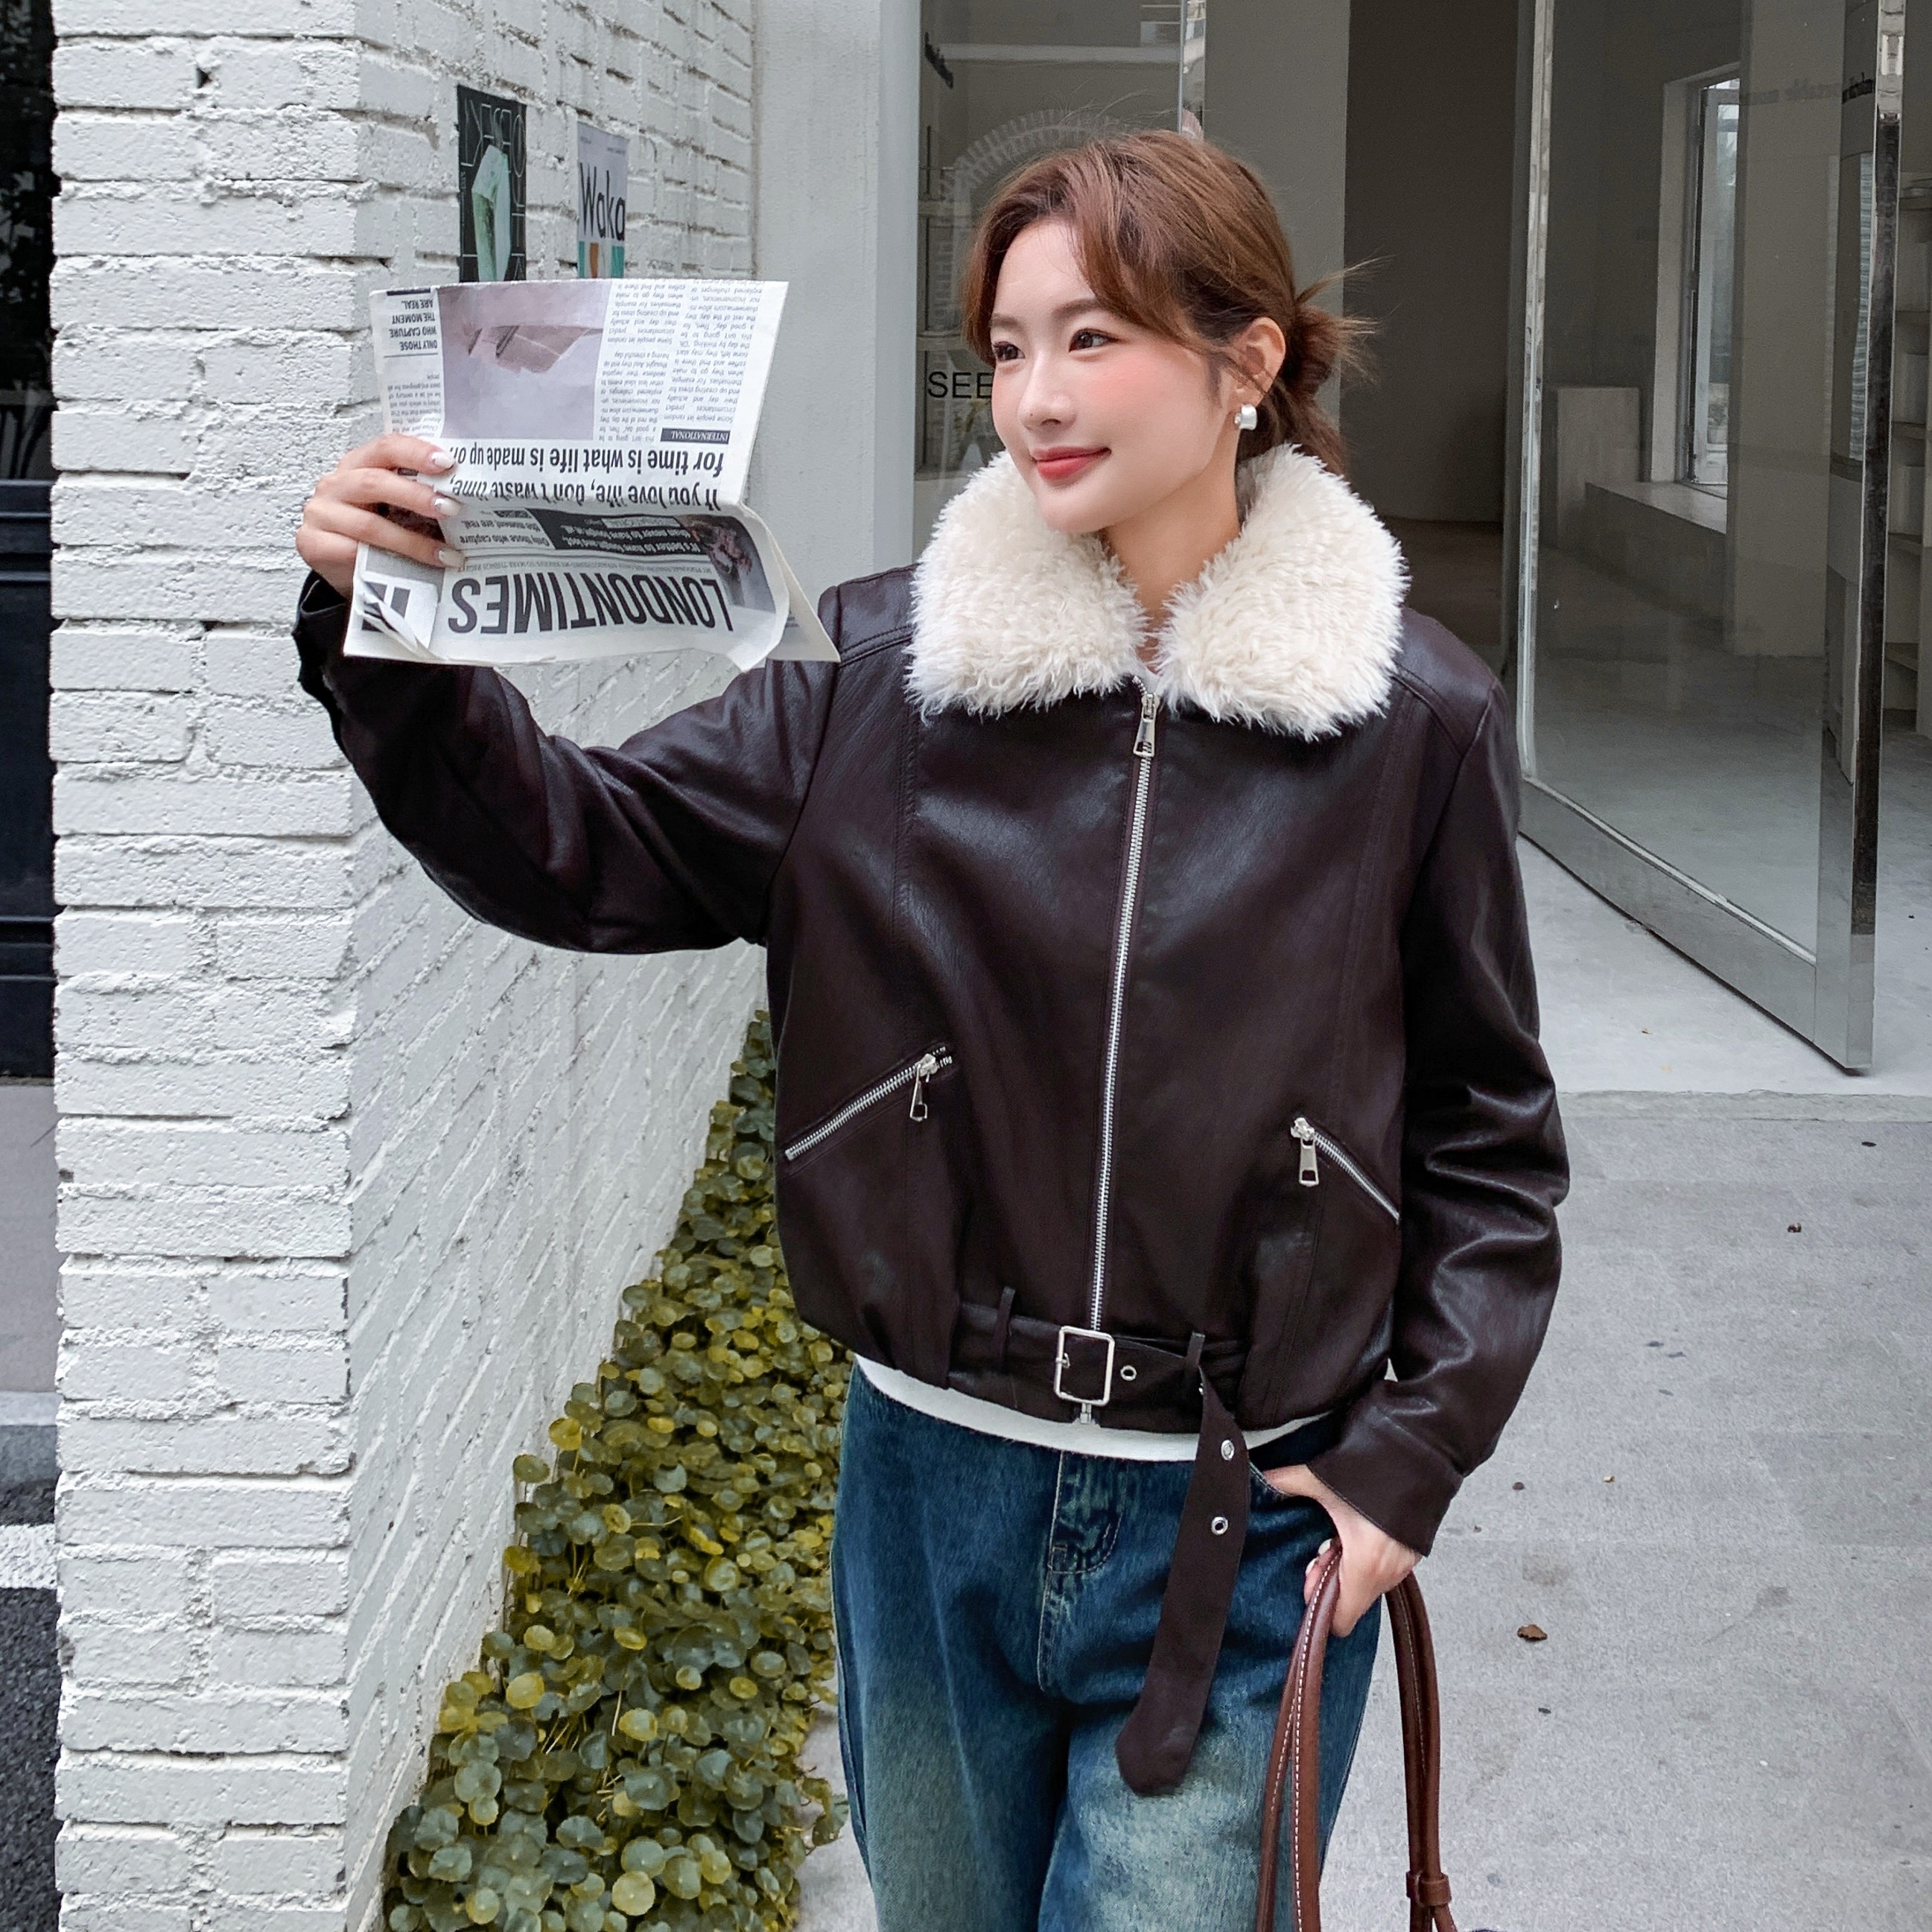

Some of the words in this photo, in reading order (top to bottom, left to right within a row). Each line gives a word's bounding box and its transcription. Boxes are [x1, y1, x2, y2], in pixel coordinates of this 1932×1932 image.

[579, 162, 626, 241] Waka
[401, 300, 419, 309] REAL.
[420, 299, 433, 308] ARE
[392, 314, 422, 324] MOMENT
[423, 313, 435, 322] THE
[389, 327, 420, 337] CAPTURE
[422, 326, 436, 335] WHO
[399, 341, 422, 351] THOSE
[423, 340, 437, 349] ONLY
[670, 431, 728, 441] INTERNATIONAL
[470, 442, 483, 465] up
[487, 448, 525, 471] made
[530, 448, 544, 471] is
[550, 449, 578, 473] life
[583, 449, 623, 474] what
[628, 450, 641, 475] is
[647, 450, 688, 475] time
[693, 453, 724, 478] for
[628, 486, 667, 509] love
[669, 482, 701, 506] you
[524, 523, 541, 533] the
[460, 534, 491, 545] capture
[492, 535, 509, 544] who
[509, 535, 533, 544] those
[448, 573, 734, 634] LONDONTIMES
